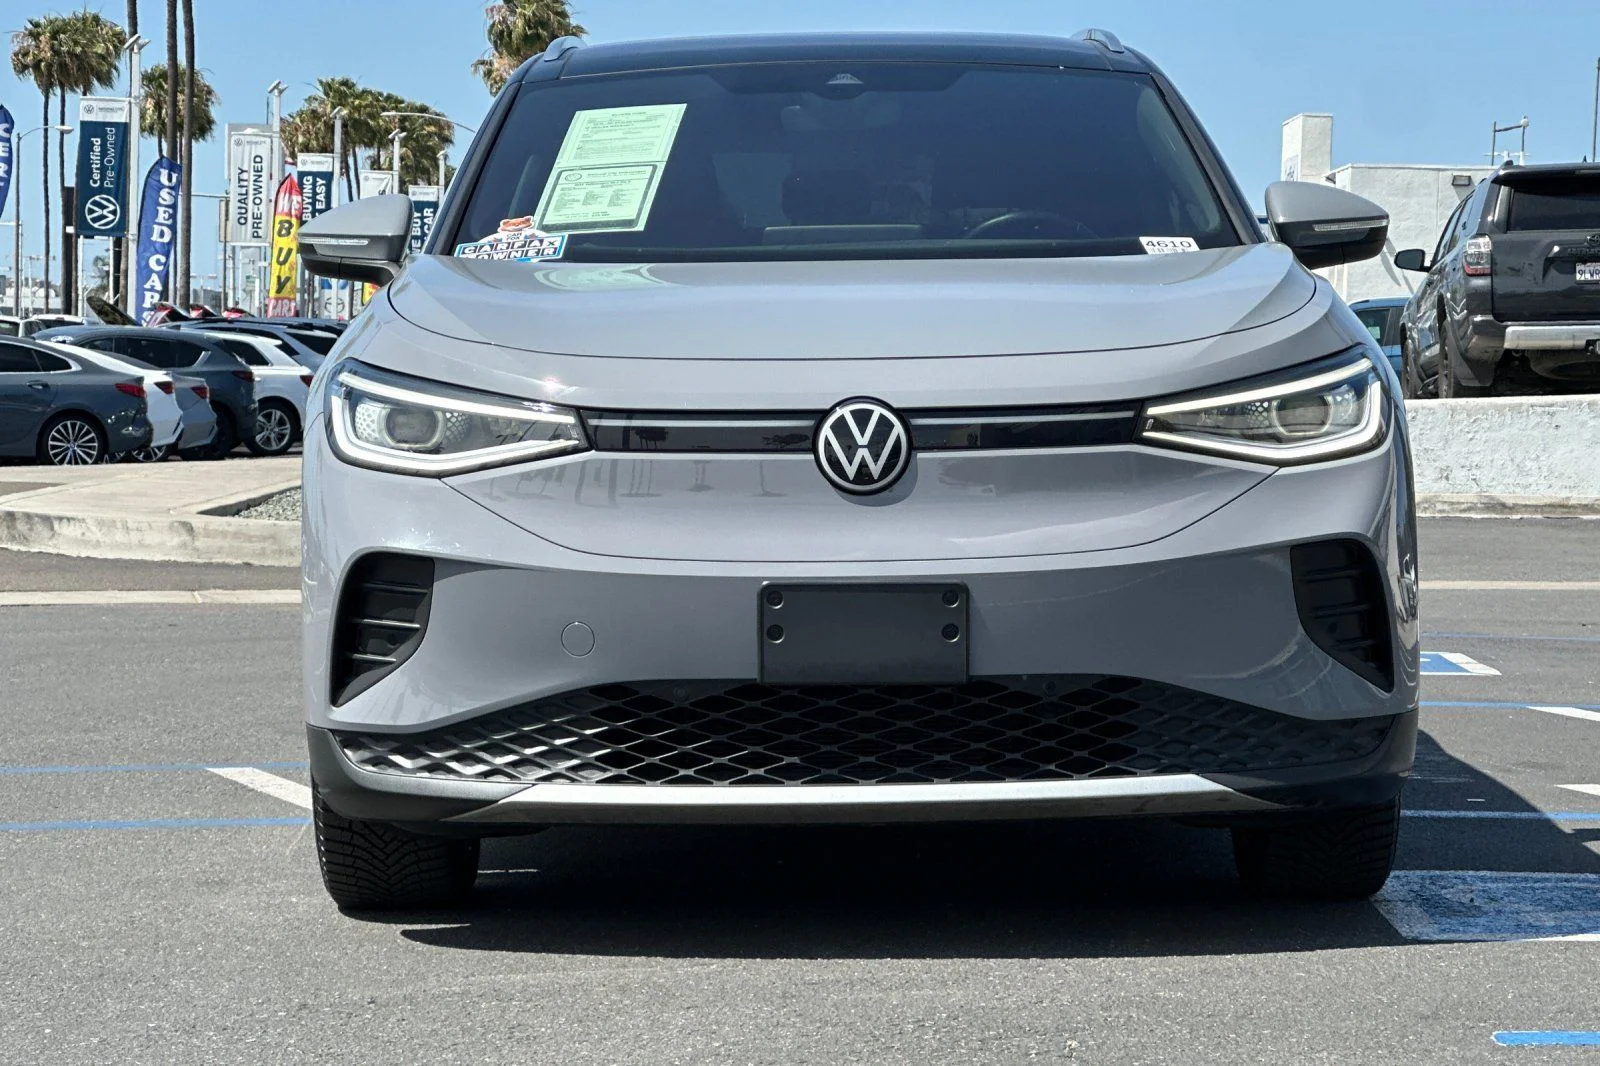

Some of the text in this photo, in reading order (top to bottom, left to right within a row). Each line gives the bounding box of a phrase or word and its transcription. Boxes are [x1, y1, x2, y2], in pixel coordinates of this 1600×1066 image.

[90, 137, 101, 187] Certified
[104, 127, 115, 188] Pre-Owned
[151, 168, 178, 243] USED
[237, 167, 248, 226] QUALITY
[252, 154, 263, 239] PRE-OWNED
[302, 175, 313, 220] BUYING
[316, 178, 326, 210] EASY
[411, 211, 422, 236] BUY
[463, 239, 557, 254] CARFAX
[1145, 240, 1192, 248] 4610
[275, 219, 294, 294] BUY
